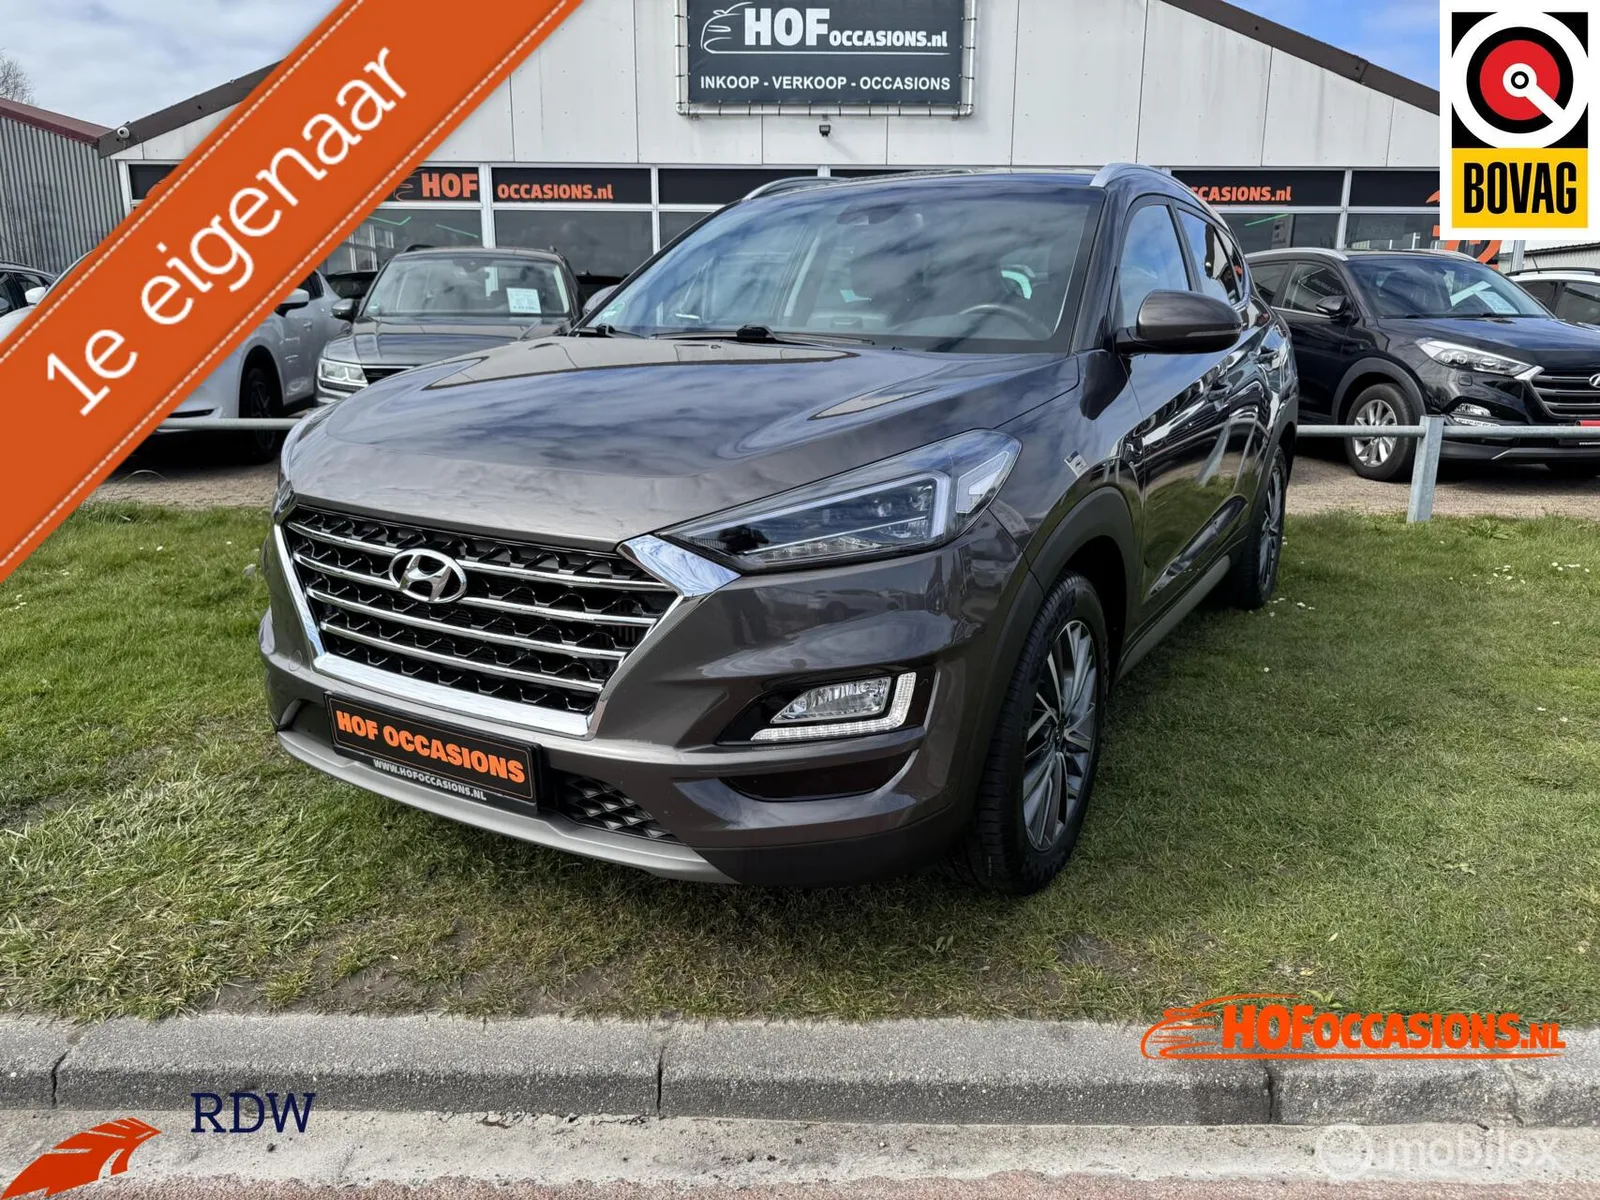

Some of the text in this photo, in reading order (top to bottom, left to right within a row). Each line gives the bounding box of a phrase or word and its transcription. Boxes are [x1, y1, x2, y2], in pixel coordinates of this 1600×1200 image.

[700, 76, 759, 90] INKOOP
[772, 76, 847, 90] VERKOOP
[859, 76, 951, 91] OCCASIONS
[421, 172, 613, 200] HOF OCCASIONS.nl
[1189, 186, 1292, 201] CASIONS.nl
[336, 709, 526, 783] HOF OCCASIONS
[373, 758, 487, 800] WWW.HOFOCCASIONS.NL
